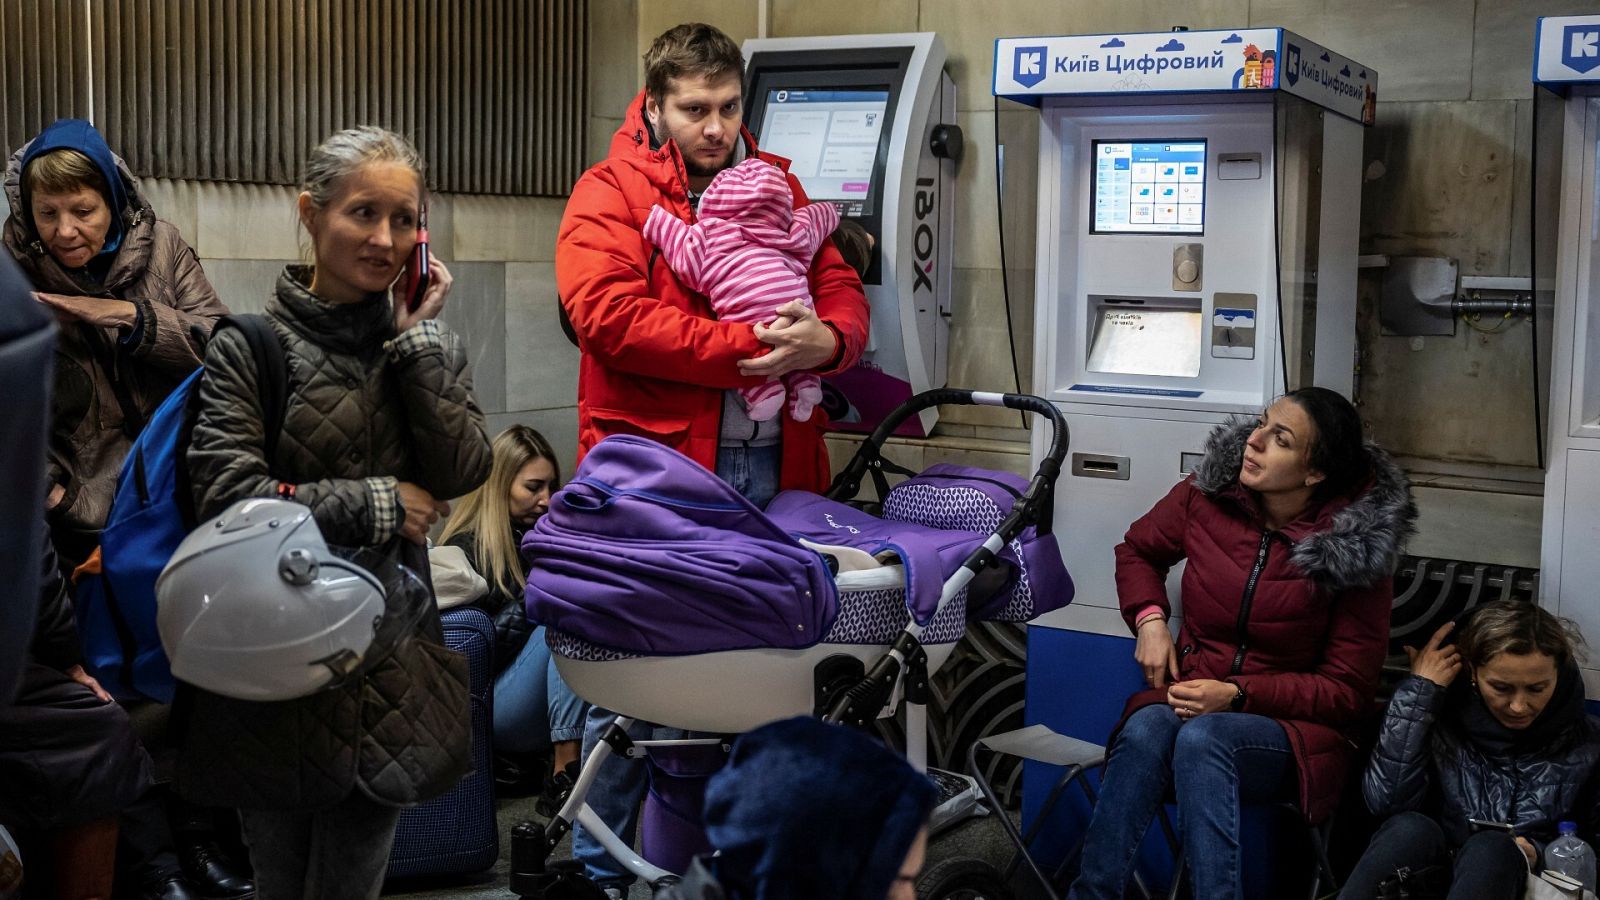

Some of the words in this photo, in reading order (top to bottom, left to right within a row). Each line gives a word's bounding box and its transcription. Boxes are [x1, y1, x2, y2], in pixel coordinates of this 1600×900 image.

[1054, 54, 1100, 73] Київ
[1106, 50, 1224, 75] Цифровий
[1301, 60, 1320, 82] Київ
[1321, 68, 1364, 102] Цифровий
